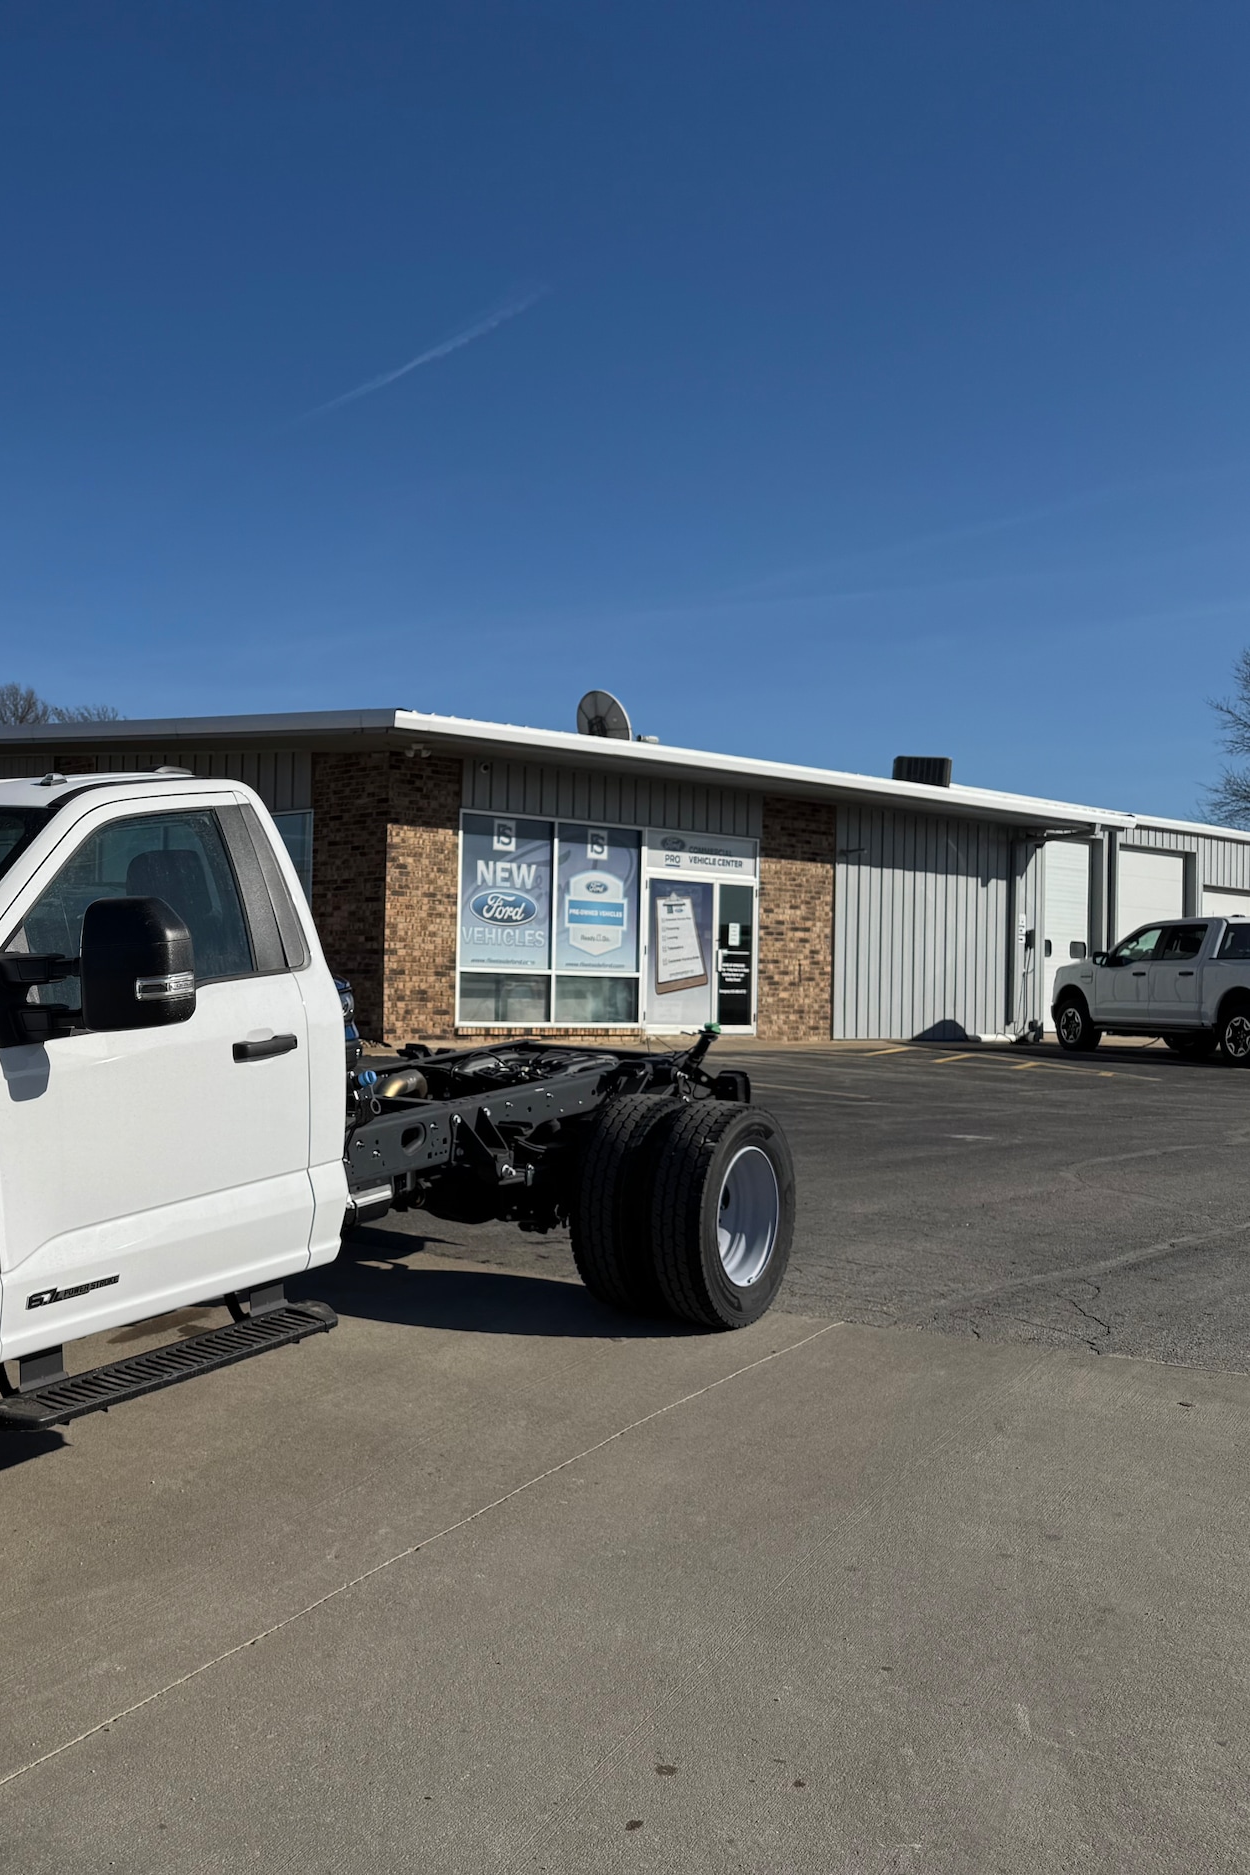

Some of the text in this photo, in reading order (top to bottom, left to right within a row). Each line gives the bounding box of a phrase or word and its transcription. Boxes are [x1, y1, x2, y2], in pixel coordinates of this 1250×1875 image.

[688, 846, 732, 856] COMMERCIAL
[664, 854, 681, 863] PRO
[688, 856, 743, 868] VEHICLE CENTER
[477, 860, 537, 889] NEW
[482, 893, 527, 920] Ford
[569, 908, 622, 918] PRE-OWNED VEHICLES
[462, 926, 545, 948] VEHICLES
[90, 1274, 120, 1290] STROKE
